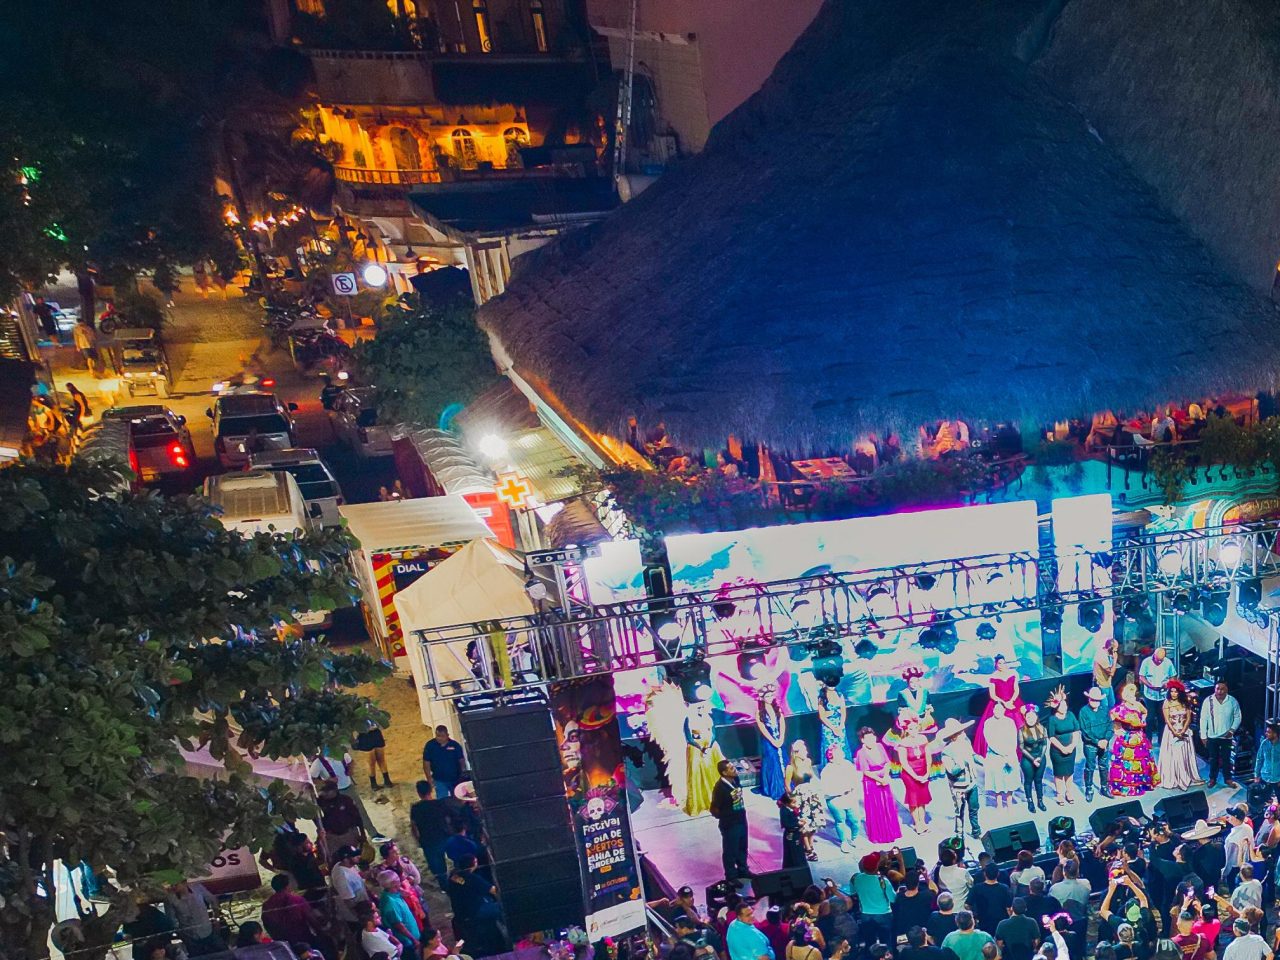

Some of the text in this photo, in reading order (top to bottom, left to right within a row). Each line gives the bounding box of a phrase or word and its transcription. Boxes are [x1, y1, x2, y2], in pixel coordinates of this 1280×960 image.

[396, 563, 425, 574] DIAL
[611, 829, 622, 838] DE
[613, 848, 625, 857] DE
